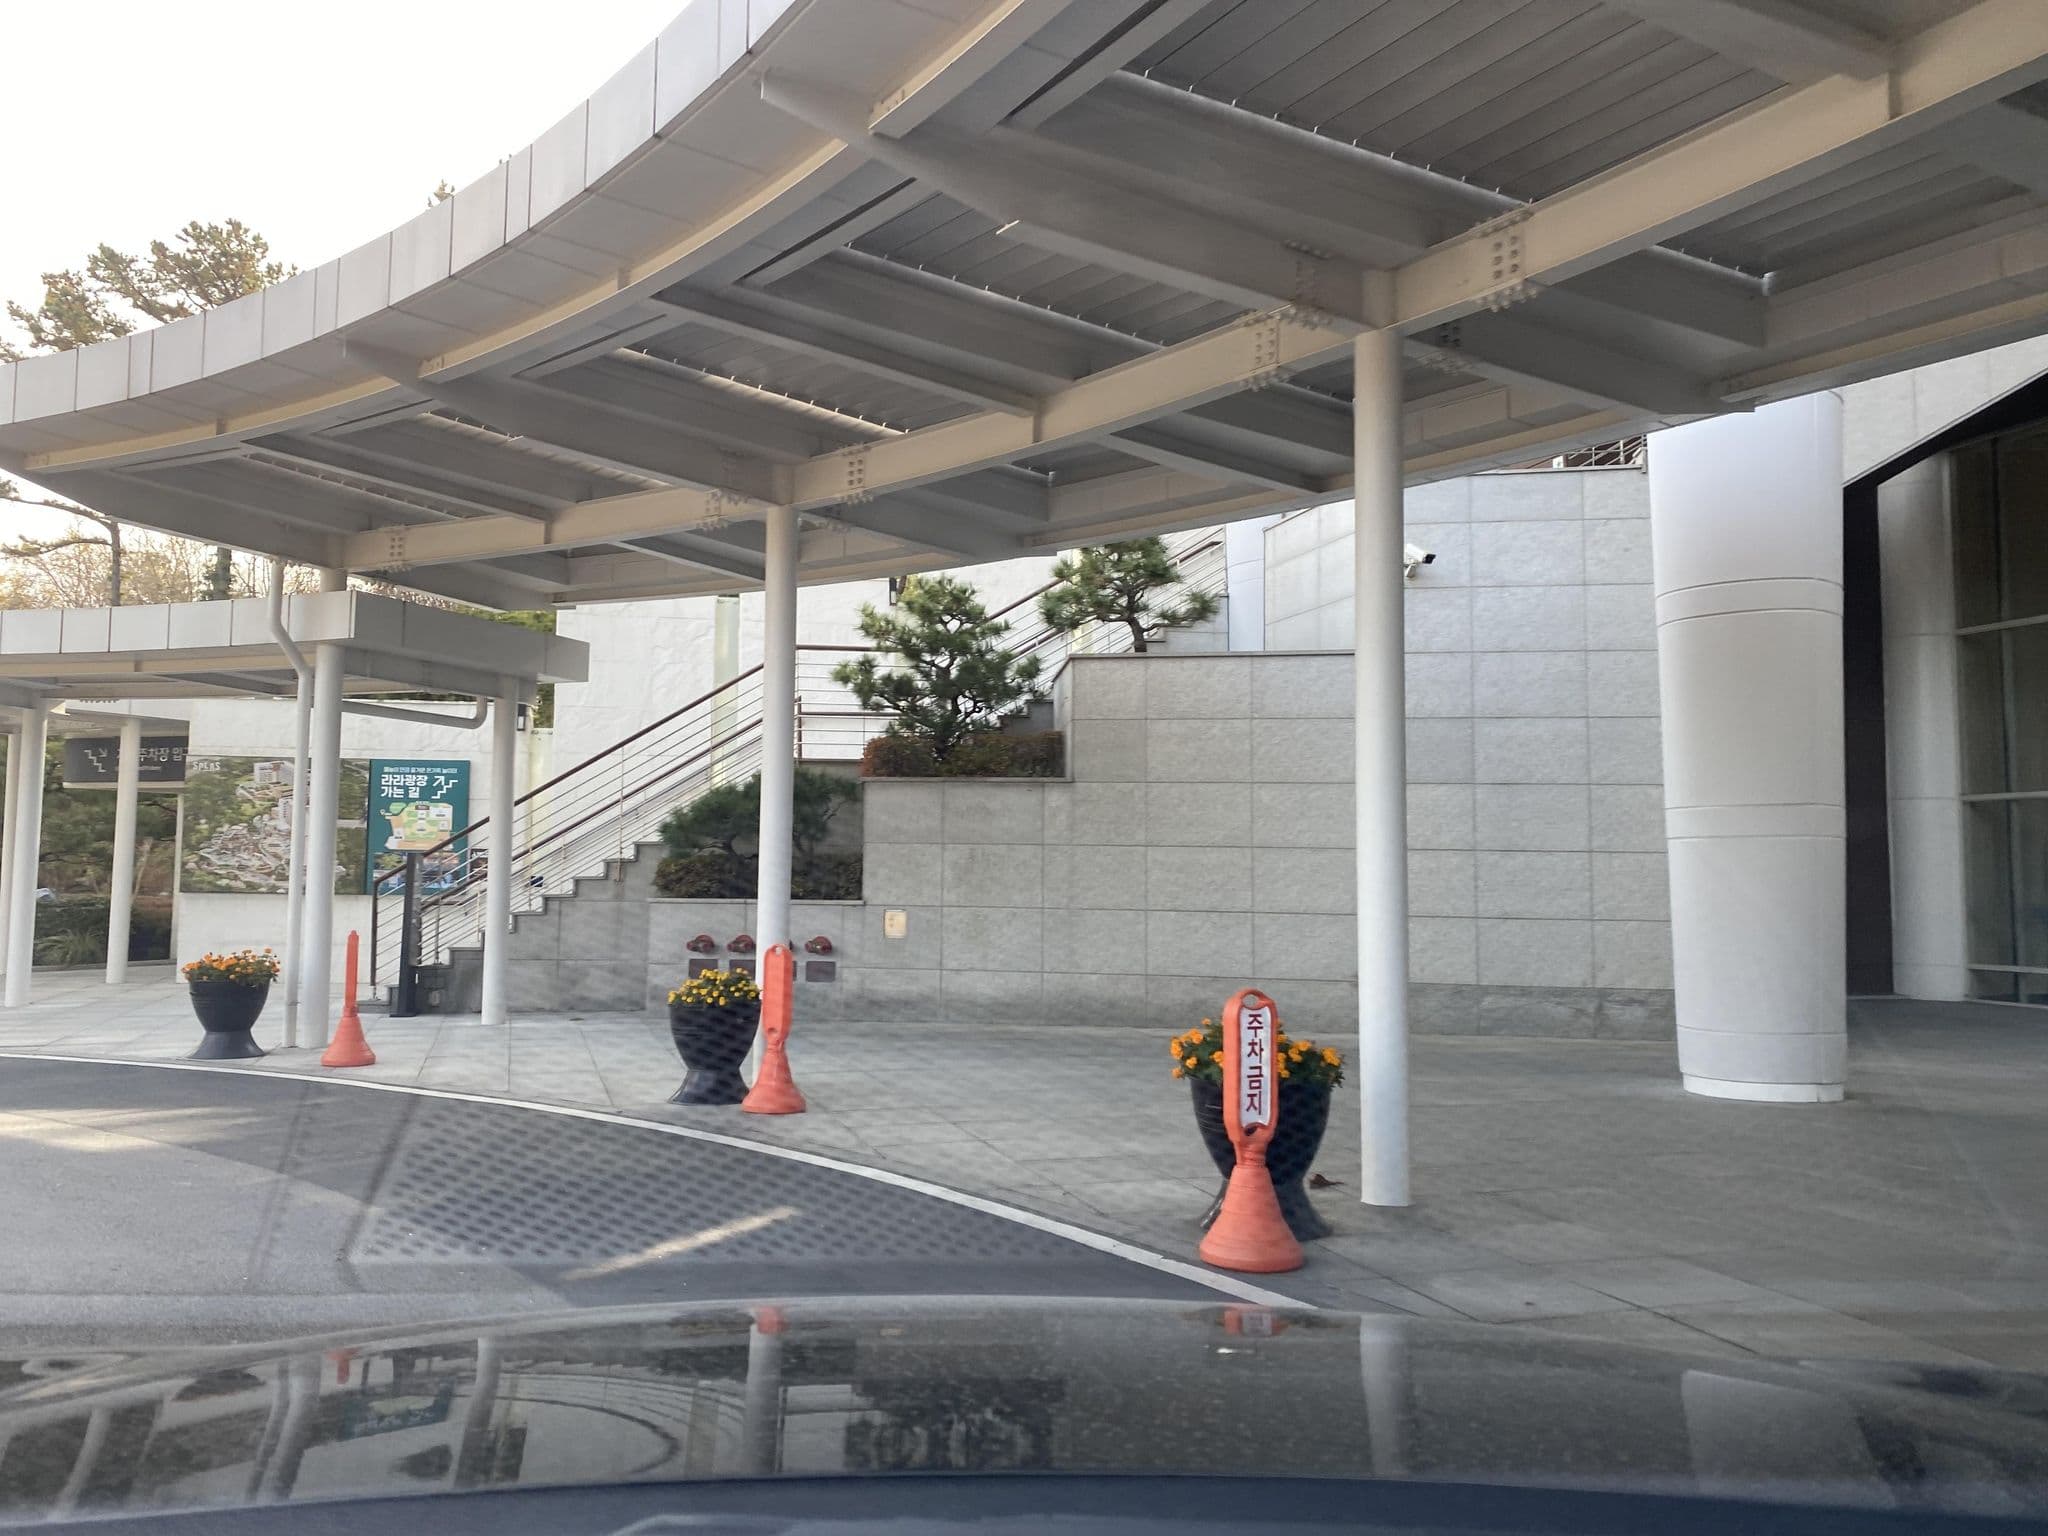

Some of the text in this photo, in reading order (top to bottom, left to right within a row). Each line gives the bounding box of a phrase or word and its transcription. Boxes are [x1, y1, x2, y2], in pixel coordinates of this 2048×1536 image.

[117, 747, 169, 761] 주차장
[381, 774, 428, 786] 라라광장
[381, 786, 420, 798] 가는 길
[1246, 1014, 1264, 1115] 주차금지
